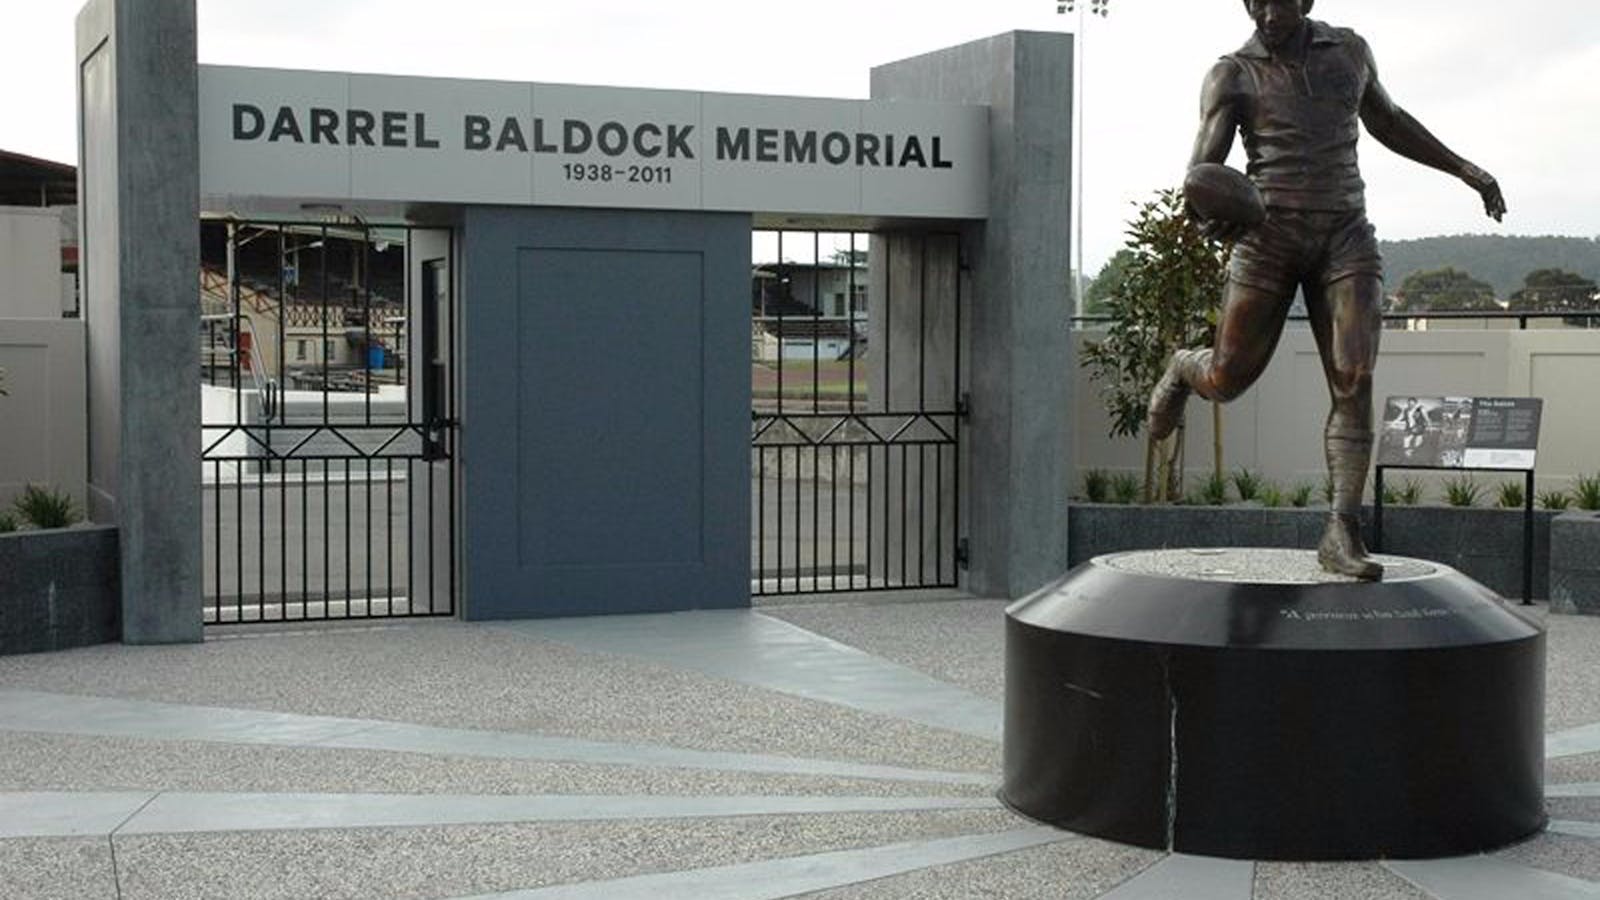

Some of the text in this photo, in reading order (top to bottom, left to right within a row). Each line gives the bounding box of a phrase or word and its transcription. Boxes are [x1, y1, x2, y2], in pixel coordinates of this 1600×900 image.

[232, 103, 954, 170] DARREL BALDOCK MEMORIAL
[563, 163, 672, 184] 1938-2011
